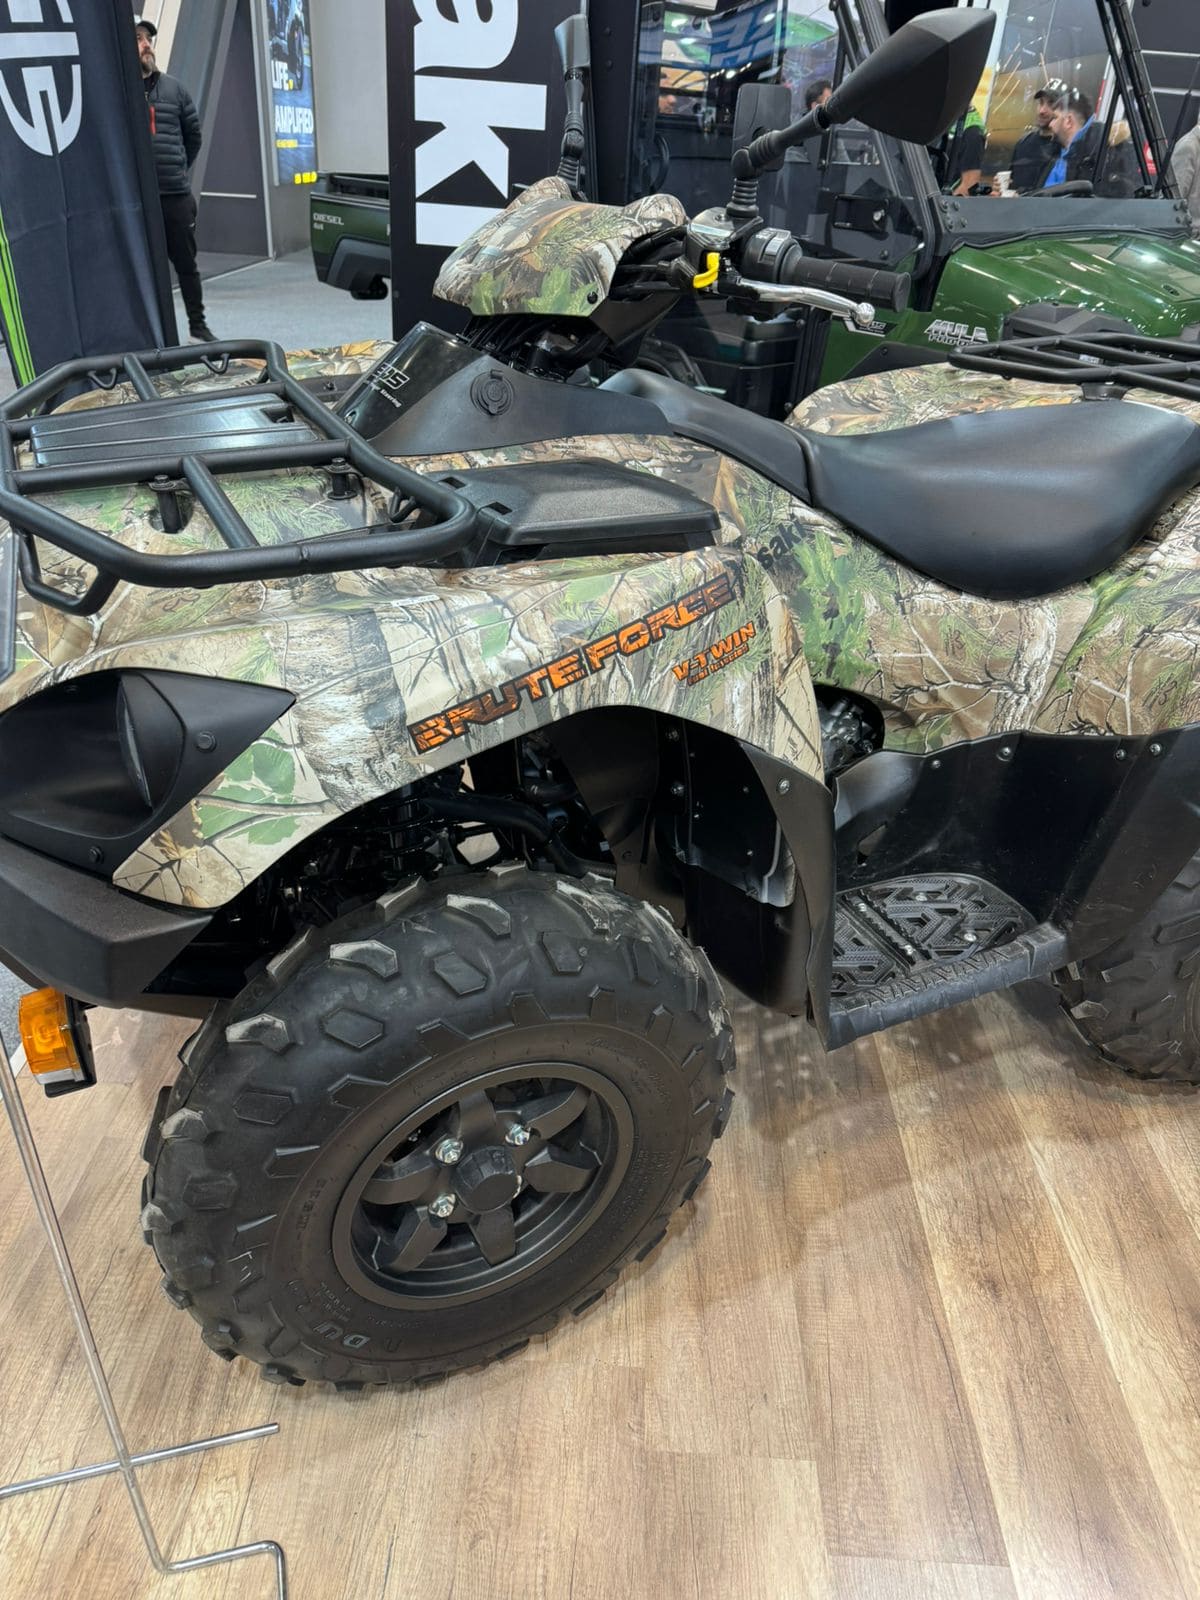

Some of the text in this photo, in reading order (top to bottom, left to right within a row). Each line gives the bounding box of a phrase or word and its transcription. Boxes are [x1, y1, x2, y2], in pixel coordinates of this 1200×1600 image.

[275, 105, 314, 134] AMPLIFIED
[313, 213, 344, 225] DIESEL
[407, 573, 736, 753] BRUTE FORCE
[672, 620, 756, 682] V-TWIN
